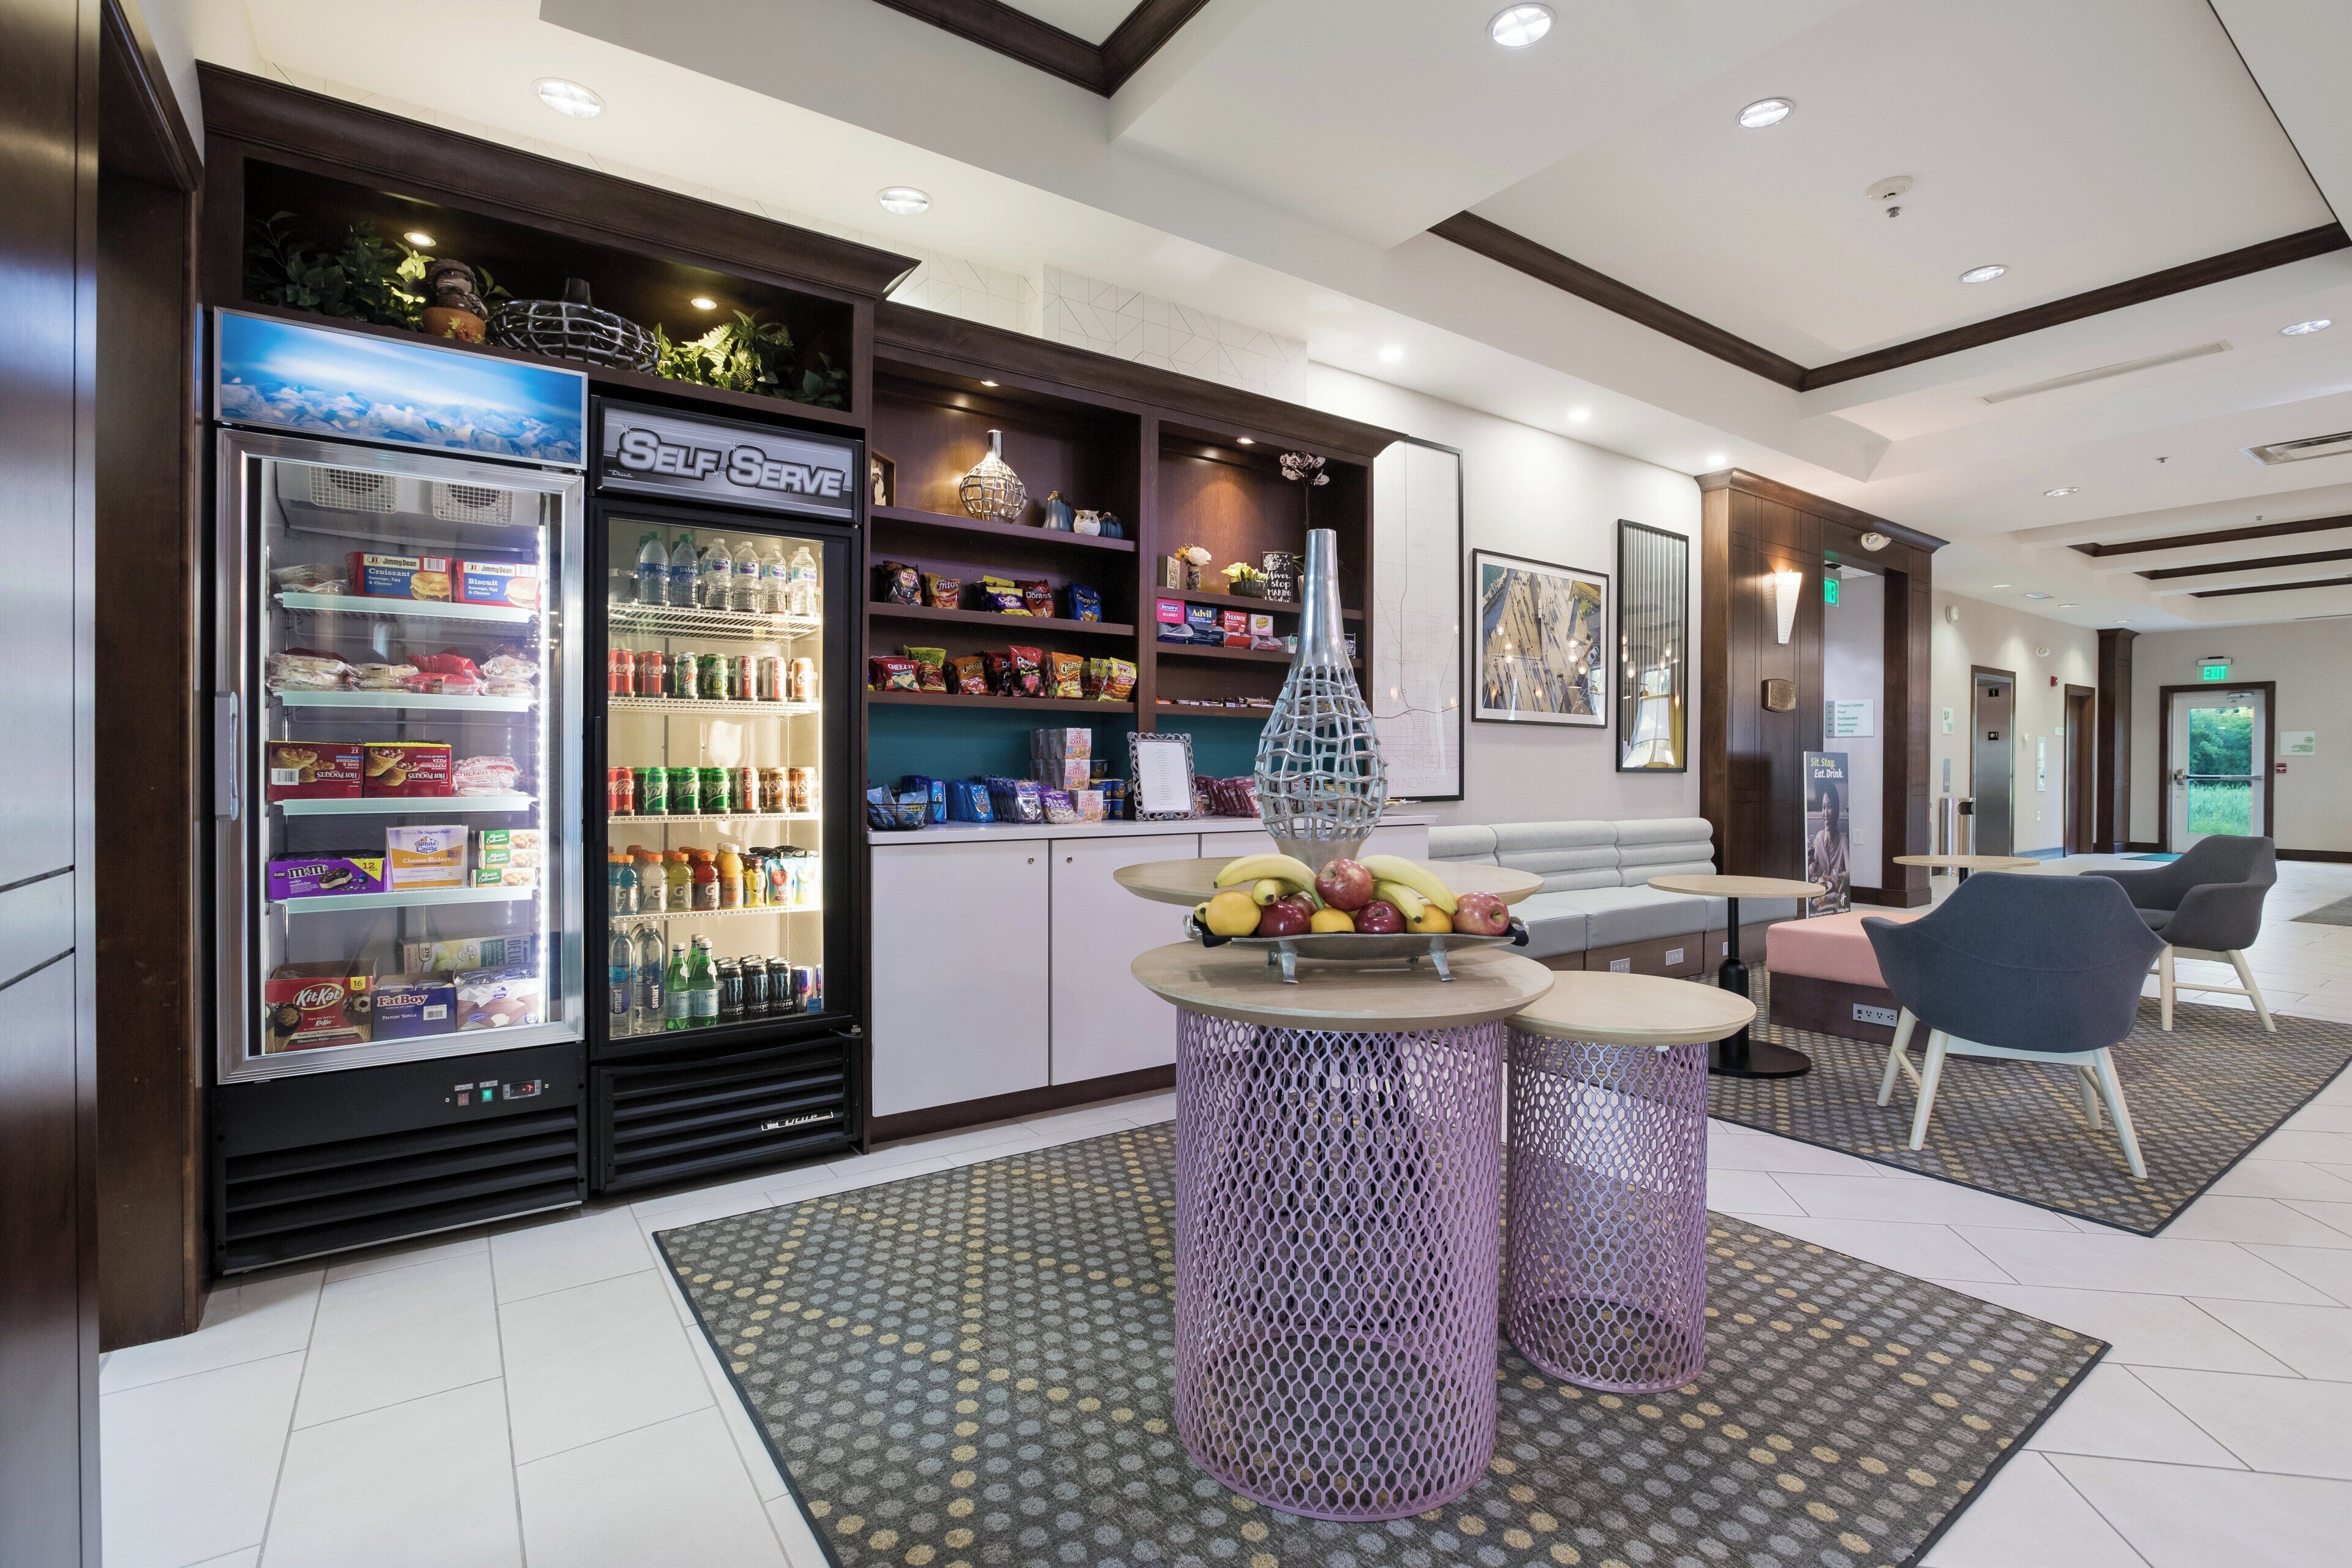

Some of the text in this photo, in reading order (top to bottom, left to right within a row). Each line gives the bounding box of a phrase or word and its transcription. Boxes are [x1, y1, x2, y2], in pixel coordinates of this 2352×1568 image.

[617, 429, 845, 499] SELF SERVE
[369, 568, 410, 577] Croissant
[1268, 571, 1291, 581] Never
[937, 579, 959, 591] Fritos
[1271, 579, 1291, 589] stop
[1076, 592, 1098, 603] Doritos
[1191, 609, 1212, 618] Advil
[1225, 613, 1246, 622] TYLENOL
[2204, 666, 2227, 680] EXIT
[1811, 757, 1836, 769] Sit. Stay.
[1814, 768, 1844, 778] Eat. Drink.
[1403, 777, 1436, 790] NORTH
[674, 886, 684, 896] G
[705, 884, 715, 895] G
[377, 995, 428, 1006] FatBoy
[650, 984, 659, 1009] smart
